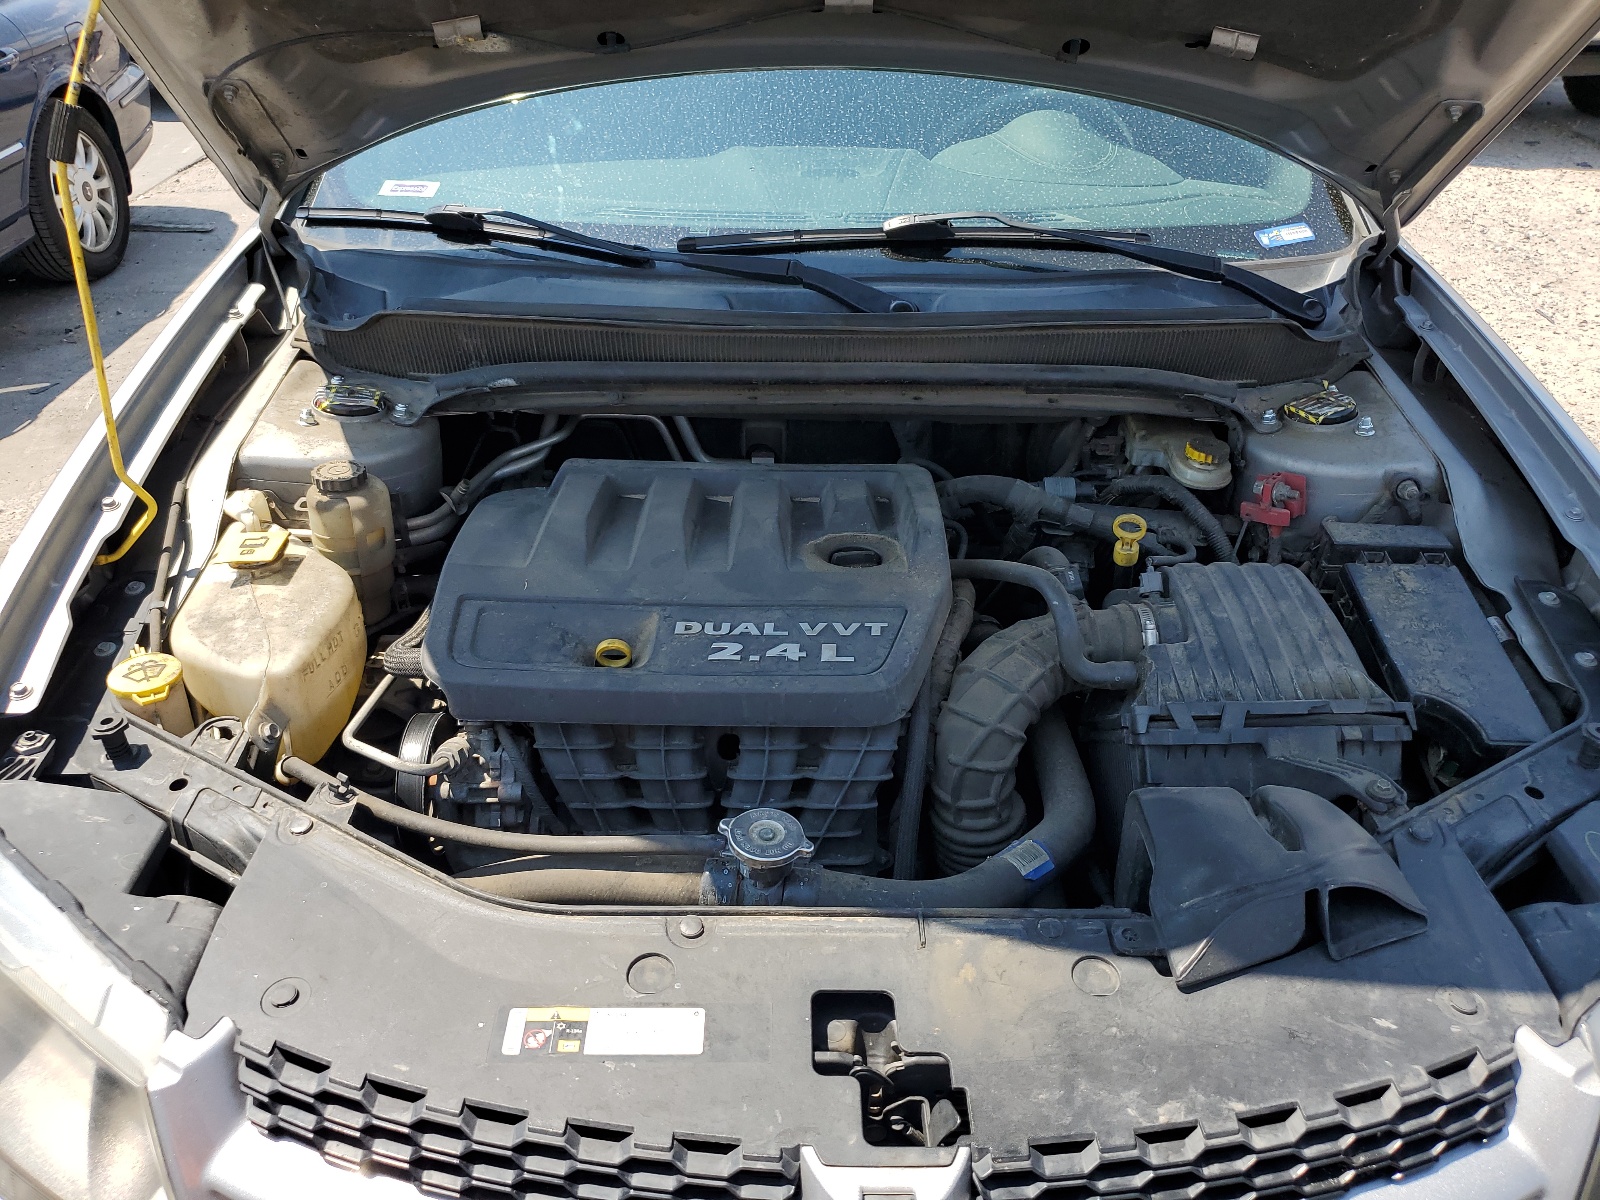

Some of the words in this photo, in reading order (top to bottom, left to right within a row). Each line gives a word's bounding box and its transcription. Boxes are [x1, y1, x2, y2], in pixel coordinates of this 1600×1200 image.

[674, 621, 789, 636] DUAL
[799, 622, 889, 636] VVT
[707, 642, 807, 662] 2.4
[821, 643, 855, 662] L
[302, 652, 327, 682] FULL
